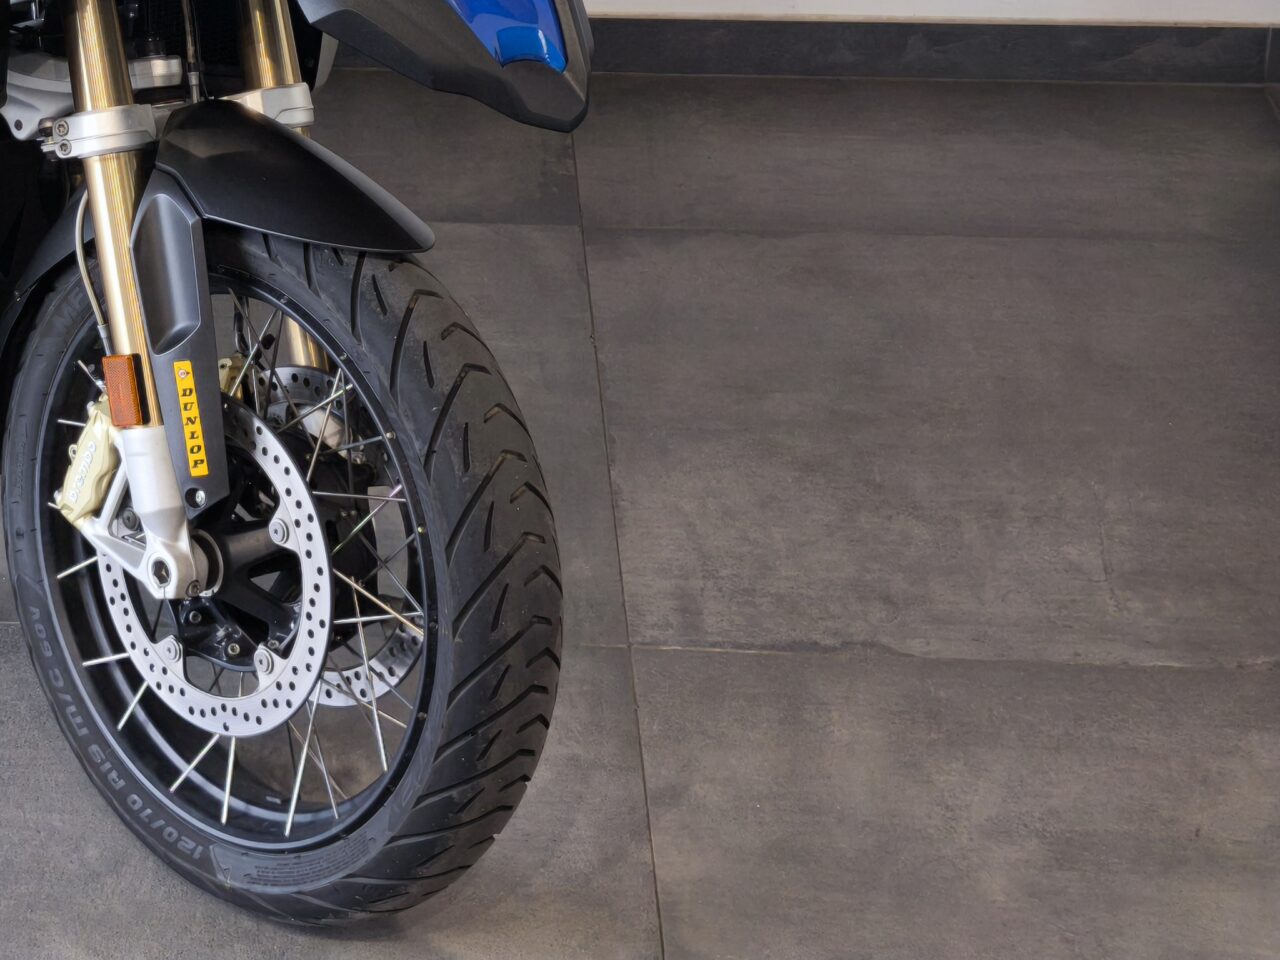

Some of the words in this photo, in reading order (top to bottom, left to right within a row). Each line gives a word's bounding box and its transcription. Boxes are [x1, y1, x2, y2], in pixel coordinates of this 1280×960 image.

[180, 387, 205, 469] DUNLOP
[28, 605, 54, 657] 60V
[86, 742, 128, 791] R19
[126, 791, 205, 861] 120/70
